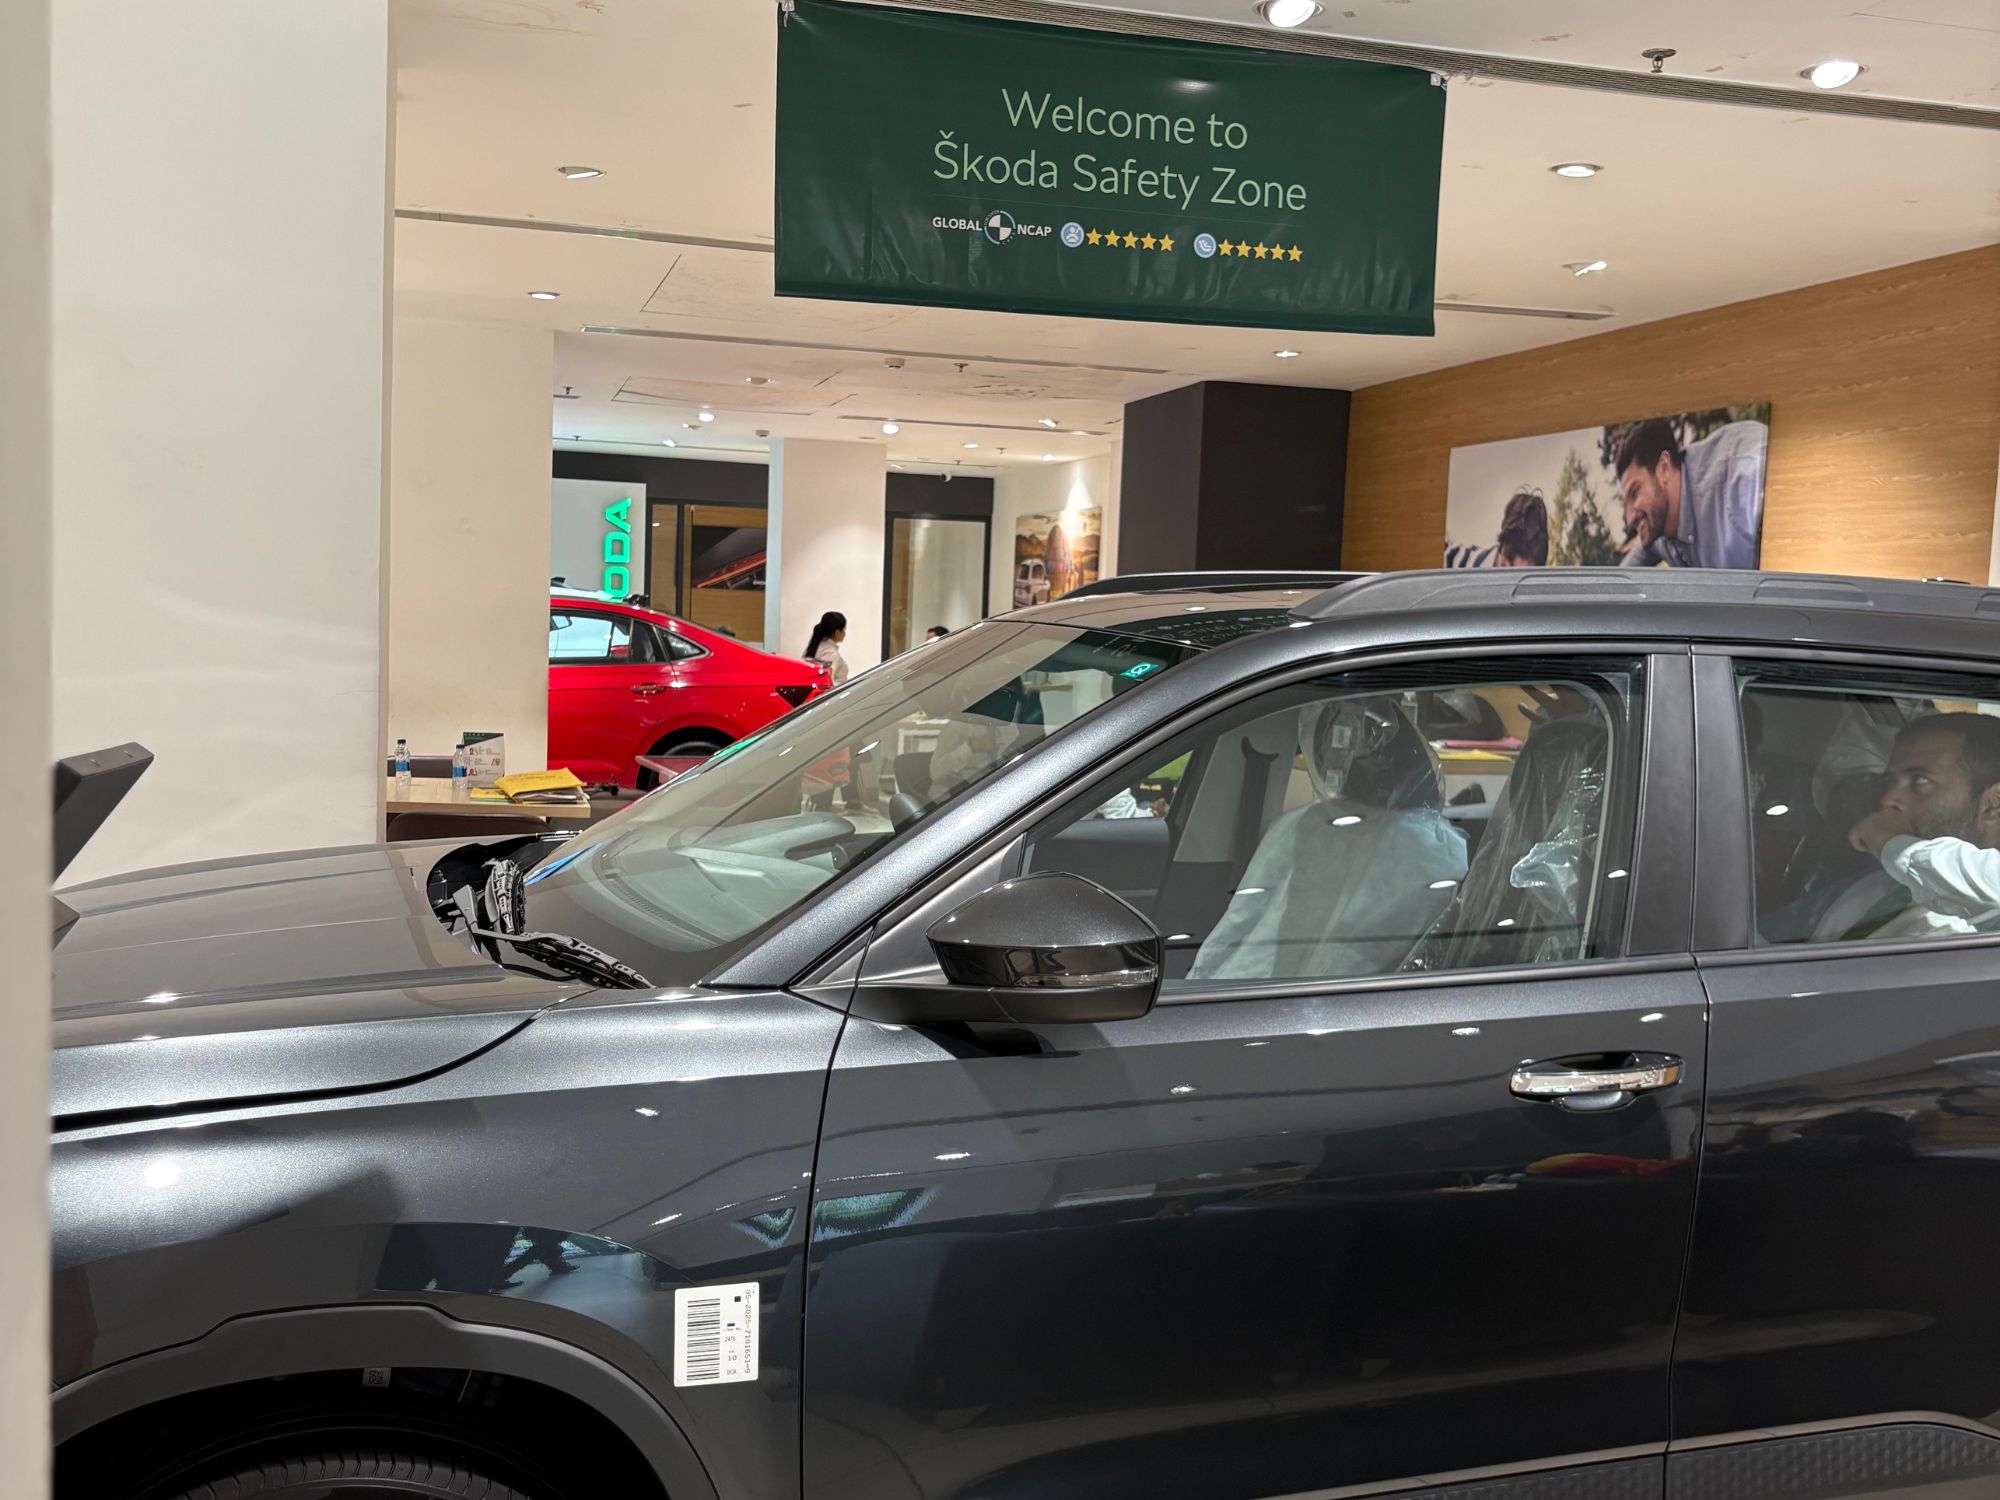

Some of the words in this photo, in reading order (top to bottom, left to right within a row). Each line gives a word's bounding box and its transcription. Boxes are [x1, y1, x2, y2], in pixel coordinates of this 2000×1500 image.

[1002, 88, 1196, 145] Welcome
[1206, 112, 1248, 150] to
[933, 129, 1059, 189] Škoda
[1072, 153, 1200, 211] Safety
[1210, 166, 1307, 211] Zone
[932, 216, 983, 232] GLOBAL
[1017, 223, 1052, 238] NCAP
